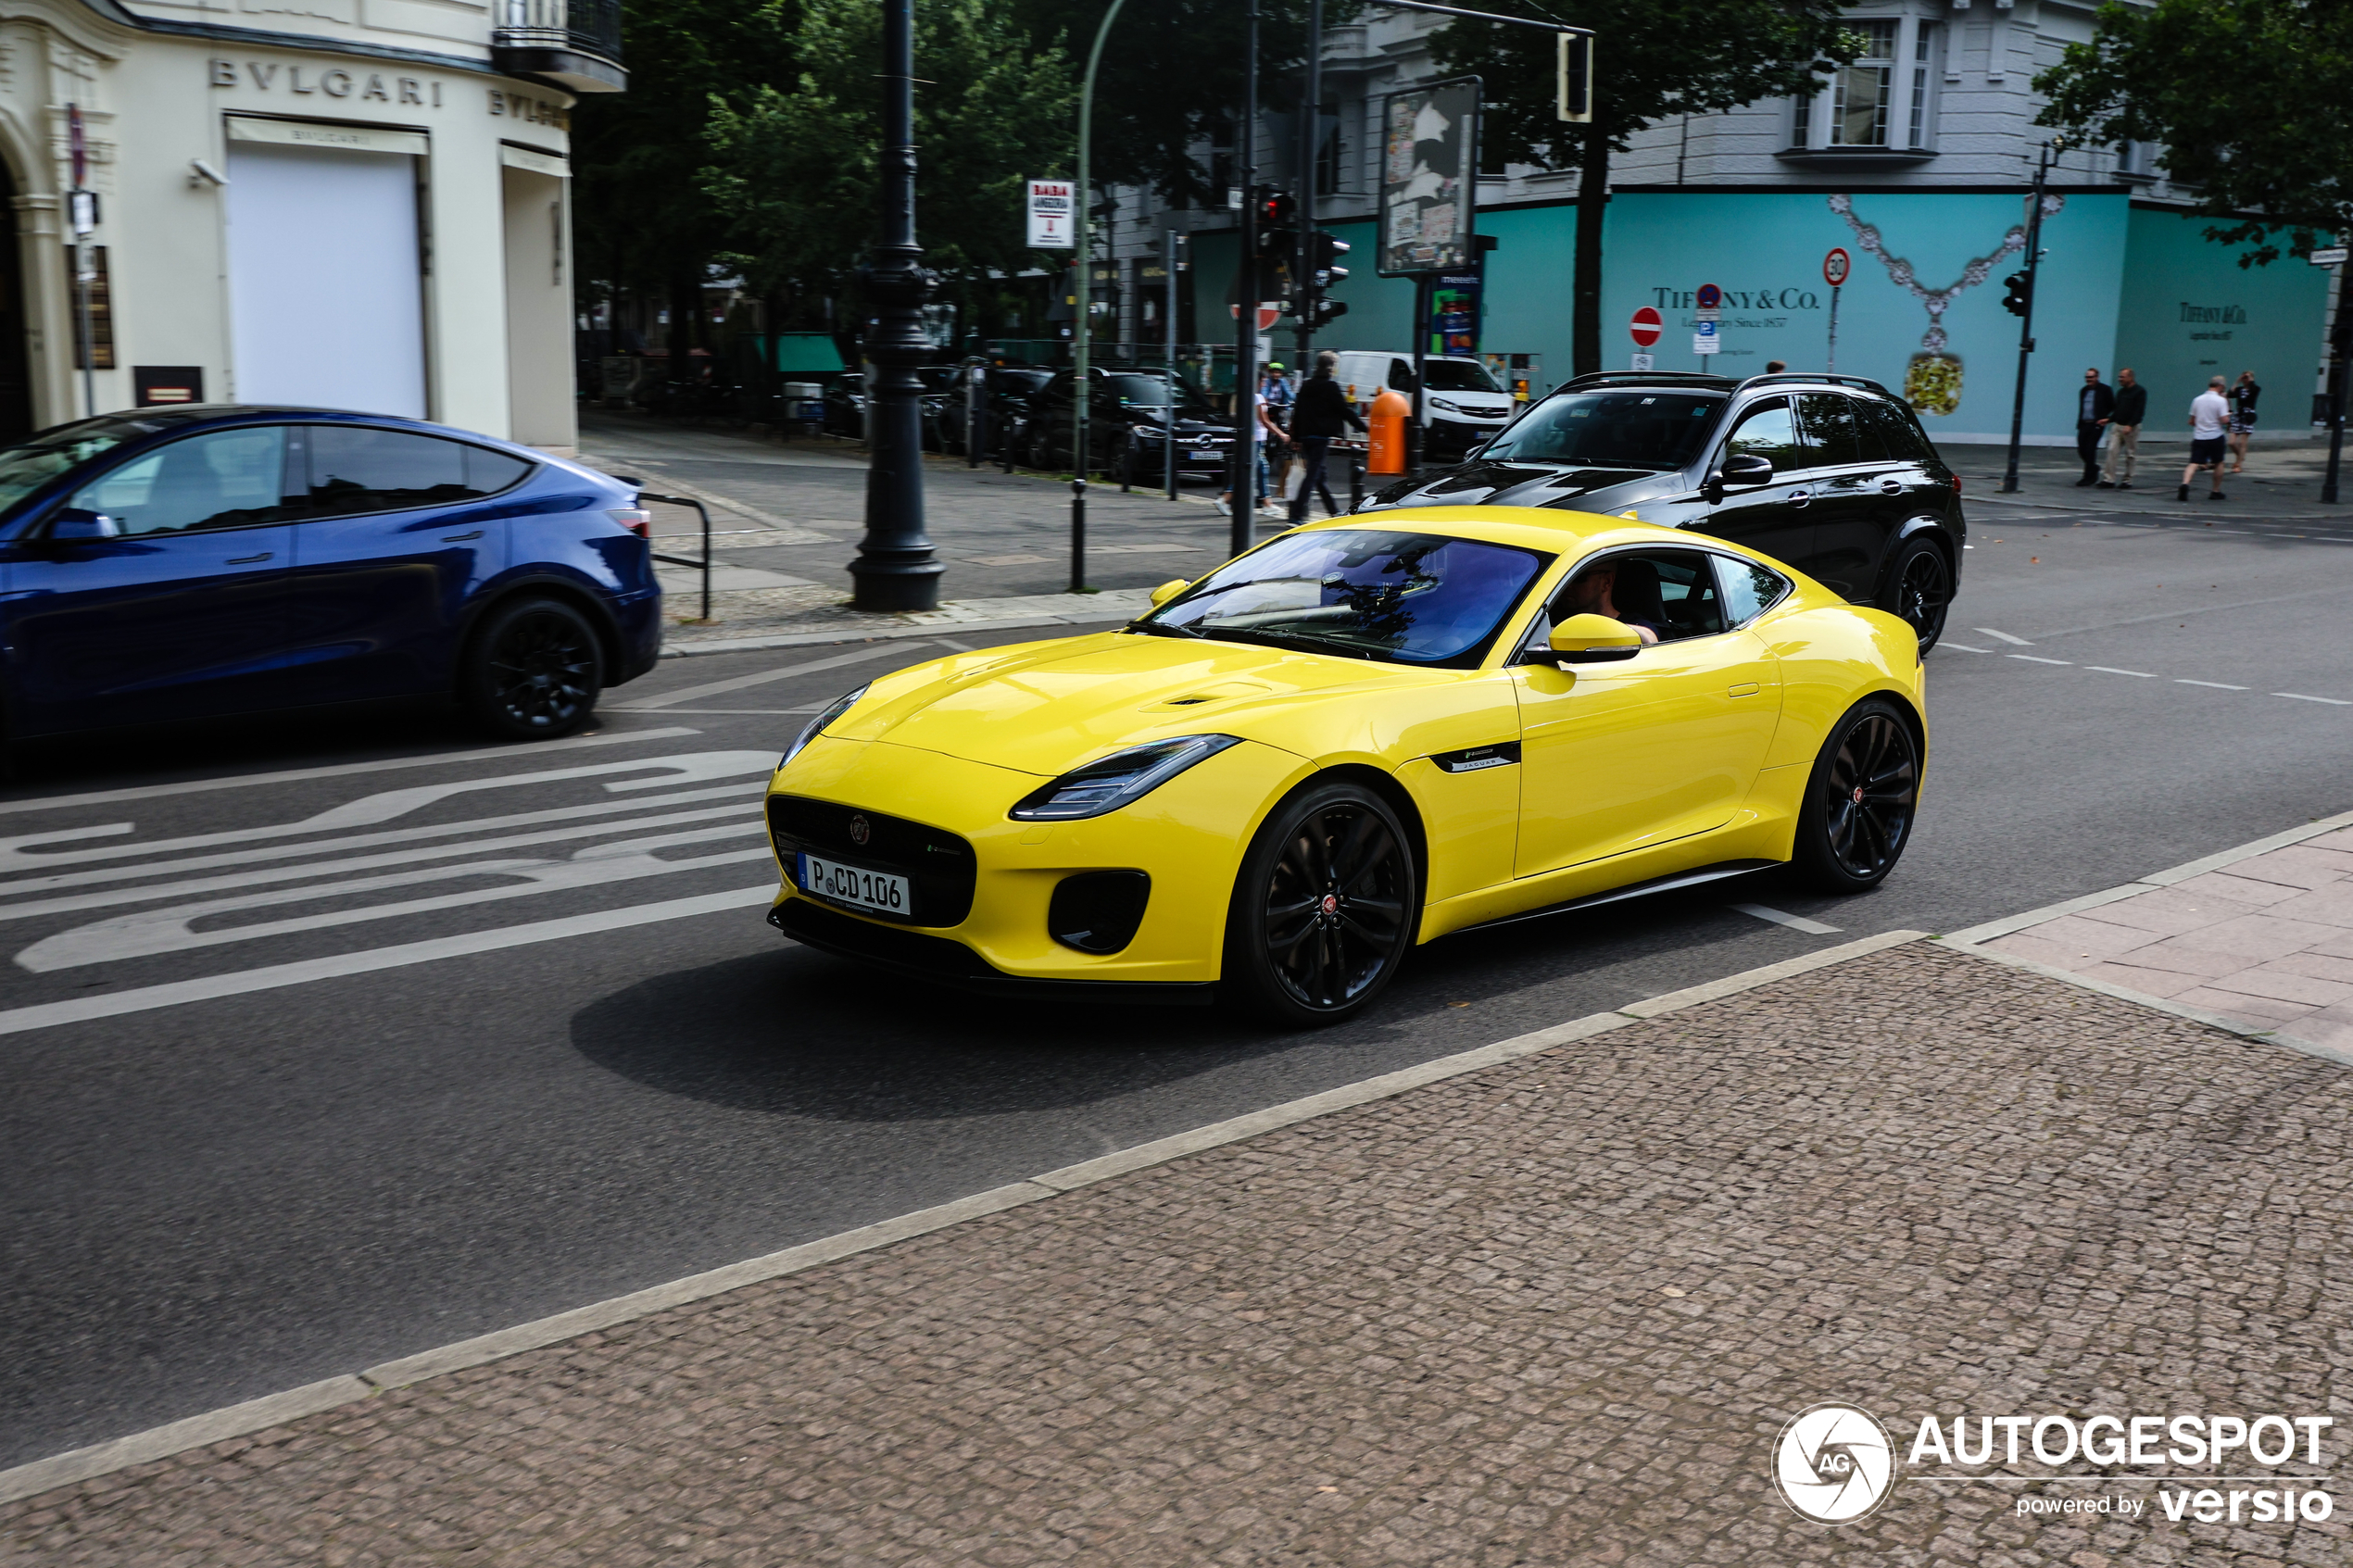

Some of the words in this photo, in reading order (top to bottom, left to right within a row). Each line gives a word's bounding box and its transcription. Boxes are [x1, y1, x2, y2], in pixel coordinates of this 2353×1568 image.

[208, 57, 445, 107] BVLGARI
[1033, 184, 1068, 196] BABA
[1828, 258, 1846, 276] 30
[1653, 287, 1755, 309] TIFNY
[1464, 759, 1496, 769] JAGUAR
[812, 860, 824, 888] P
[835, 867, 860, 899] CD
[862, 873, 901, 909] 106
